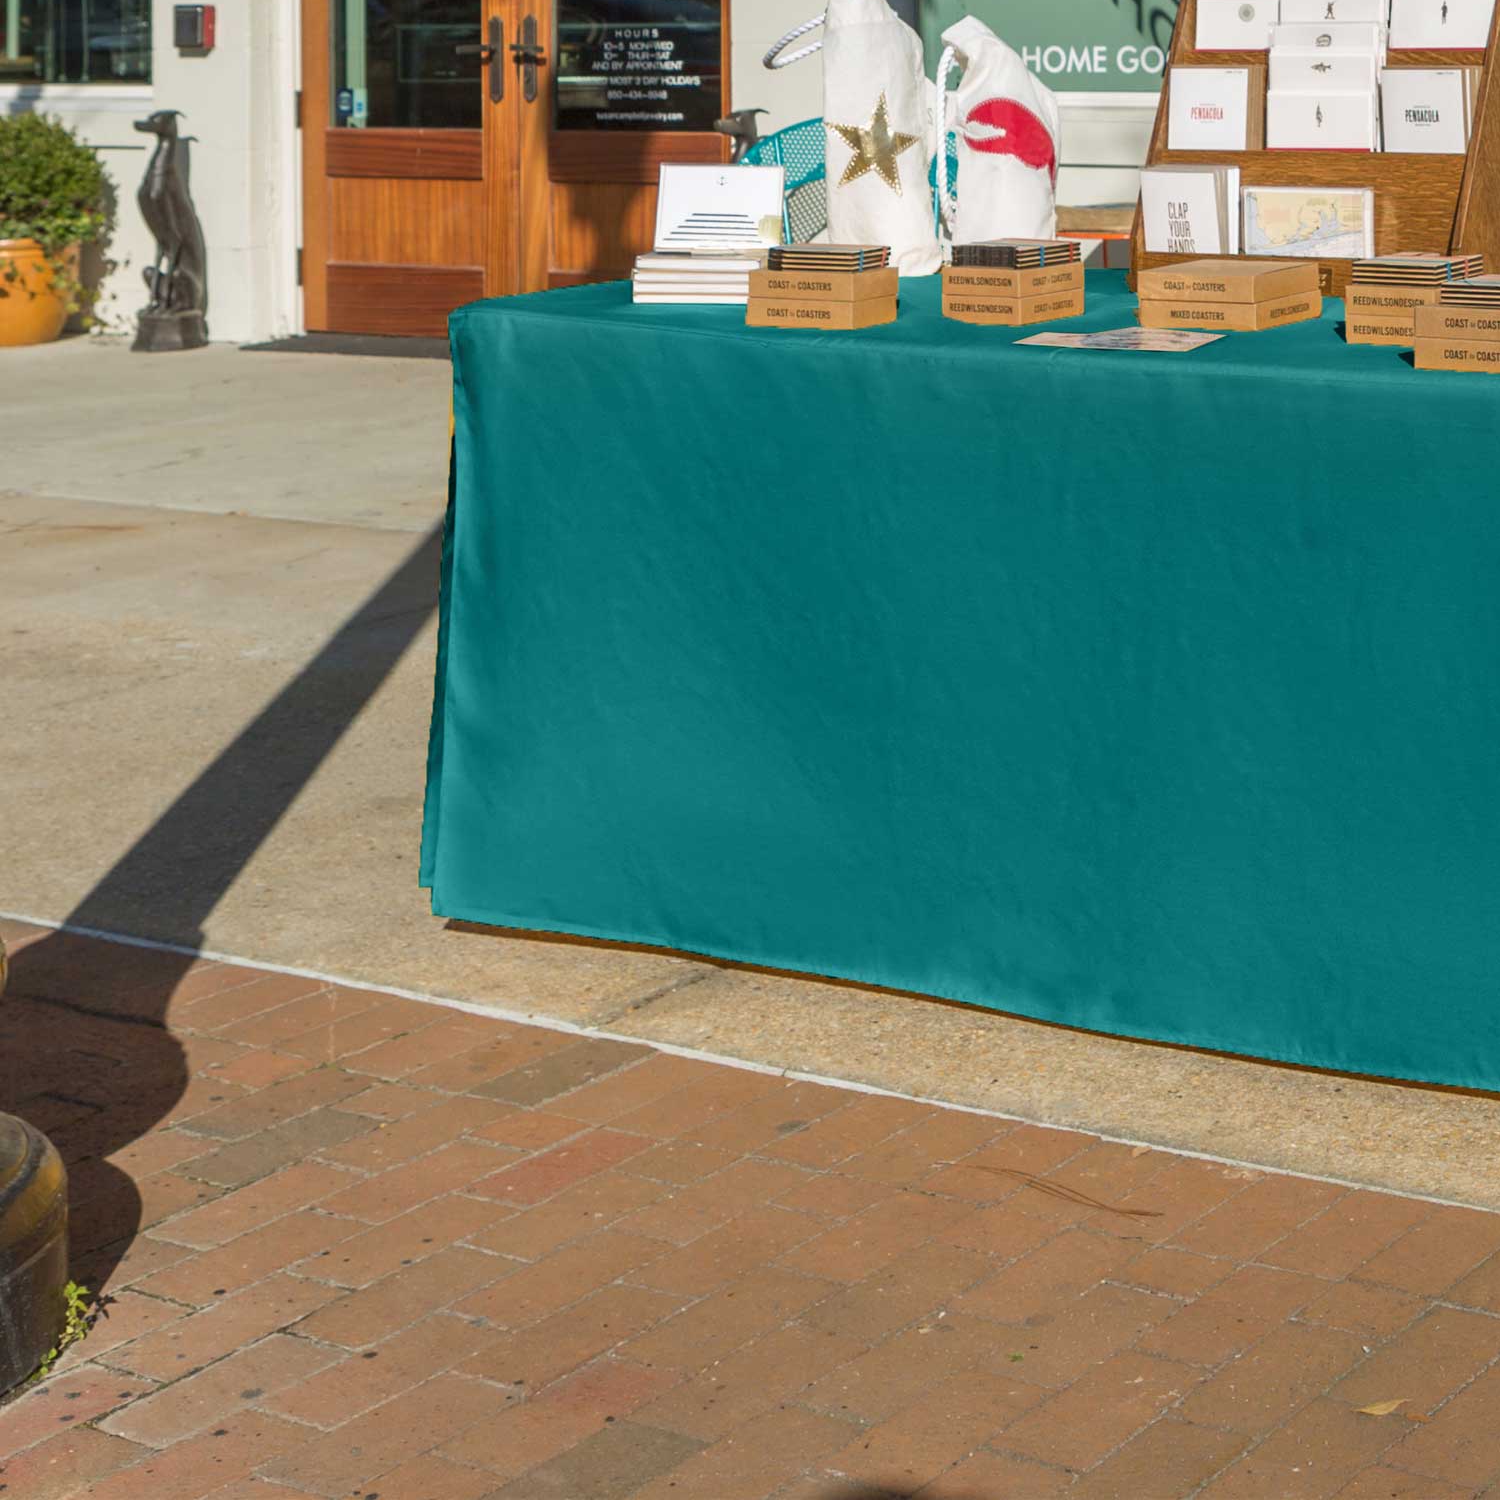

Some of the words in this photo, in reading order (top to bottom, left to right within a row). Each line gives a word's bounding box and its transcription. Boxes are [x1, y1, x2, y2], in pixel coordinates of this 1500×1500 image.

[615, 28, 659, 39] HOURS
[1022, 45, 1107, 74] HOME
[1116, 45, 1168, 74] GO
[611, 61, 623, 70] BY
[626, 60, 684, 71] APPOINTMENT
[661, 76, 701, 86] HOLIDAYS
[1190, 107, 1224, 120] PENSACOLA
[1405, 109, 1440, 123] PENSACOLA
[1167, 202, 1189, 219] CLAP
[1168, 221, 1191, 238] YOUR
[1167, 239, 1196, 253] HANDS
[768, 280, 790, 289] COAST
[797, 281, 832, 291] COASTERS
[949, 276, 1012, 287] REEDWILSONDESIGN
[1163, 281, 1185, 290] COAST
[1192, 282, 1226, 292] COASTERS
[1353, 296, 1424, 307] REEDWILSONDESIGN
[767, 308, 788, 317] COAST
[796, 309, 831, 319] COASTERS
[949, 302, 1013, 314] REEDWILSONDESIGN
[1170, 310, 1190, 319] MIXED
[1191, 311, 1225, 320] COASTERS
[1445, 318, 1469, 328] COAST
[1444, 350, 1468, 360] COAST
